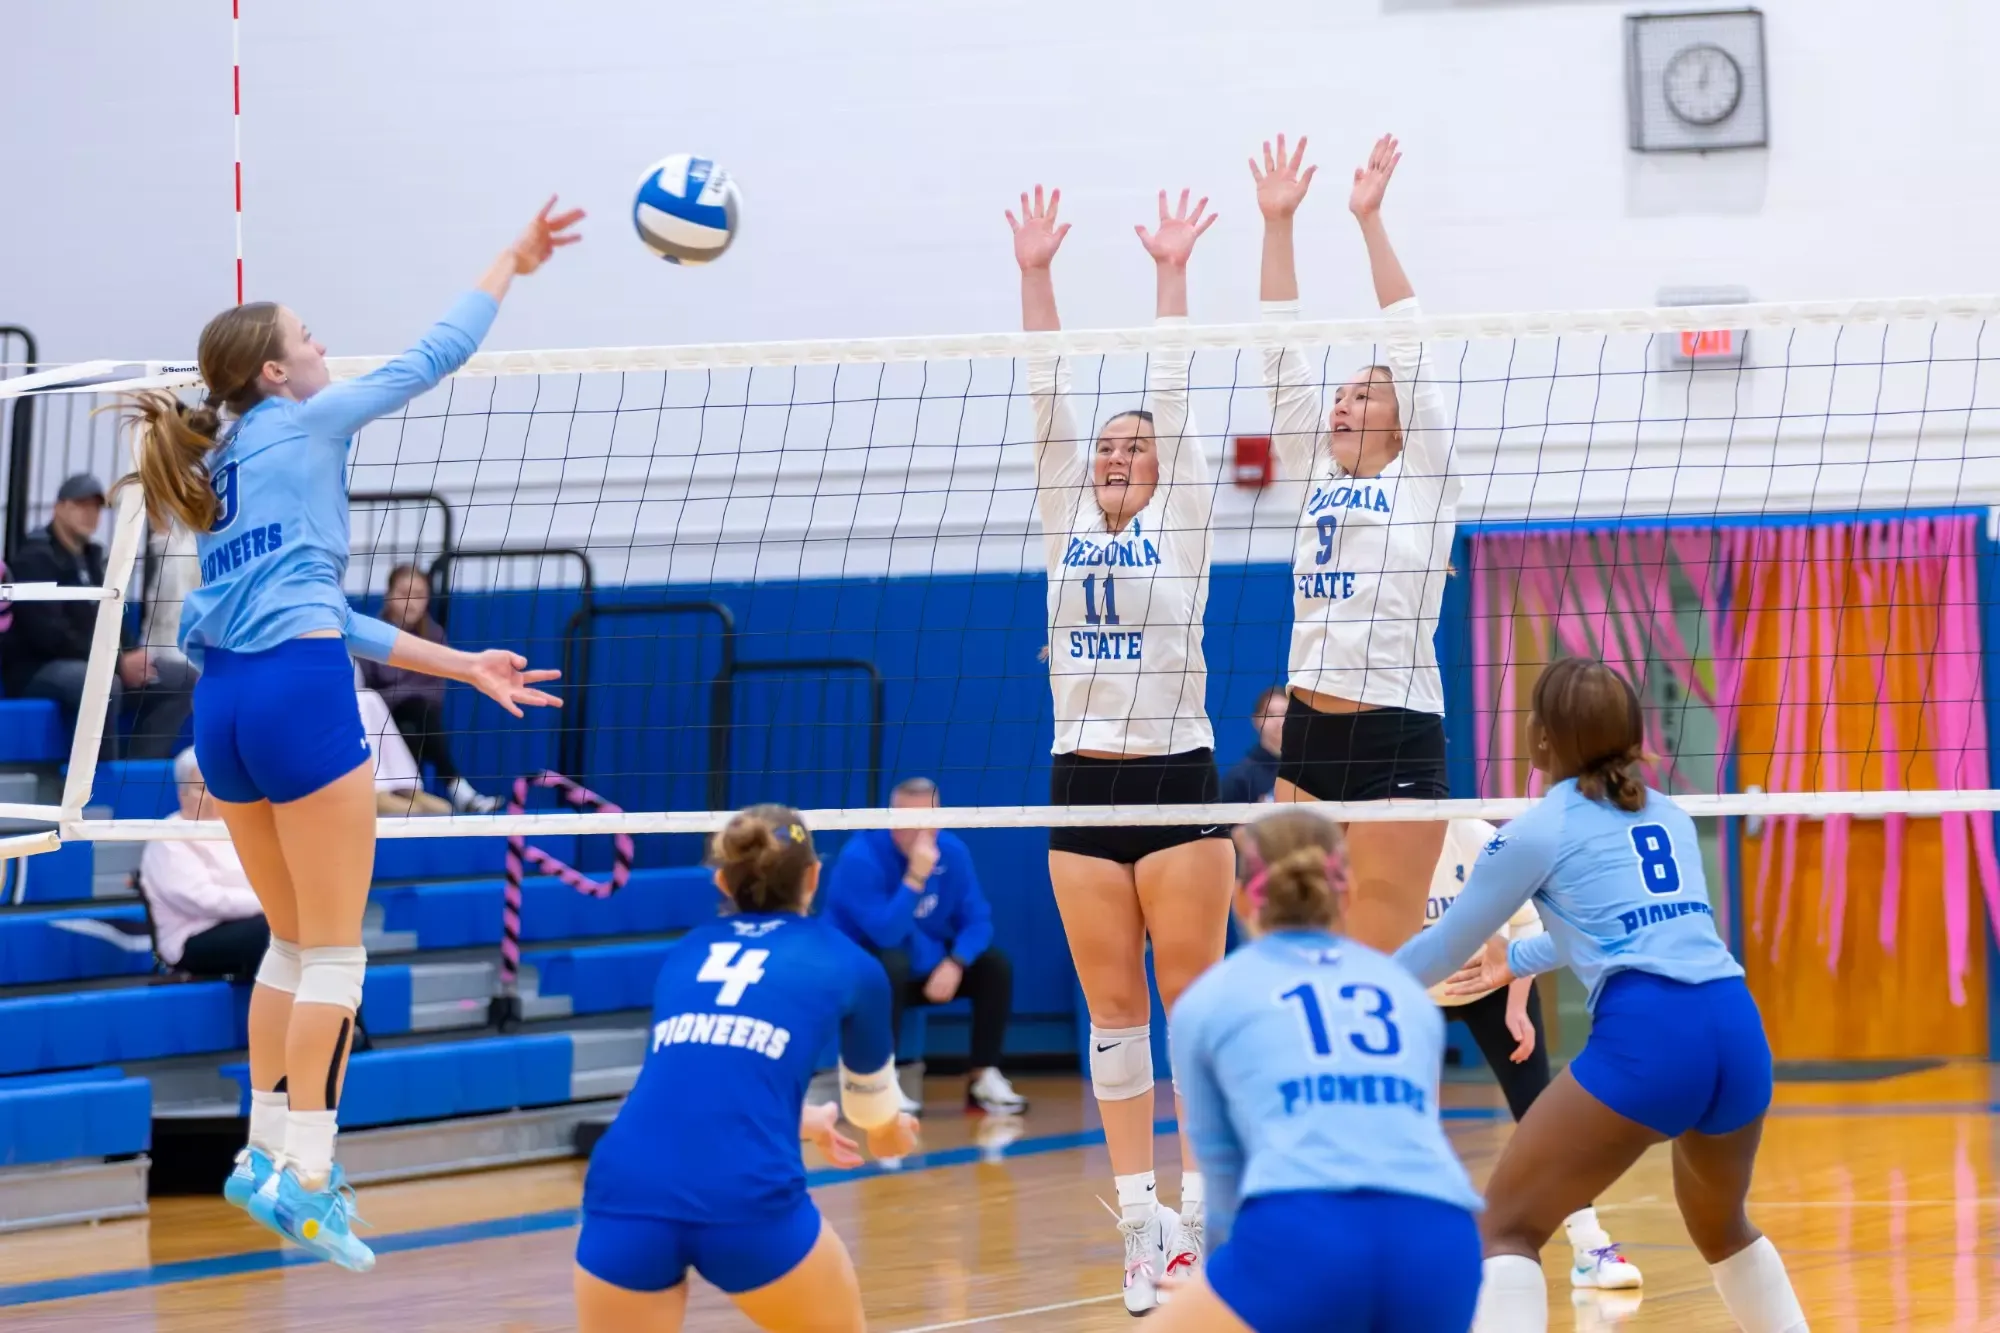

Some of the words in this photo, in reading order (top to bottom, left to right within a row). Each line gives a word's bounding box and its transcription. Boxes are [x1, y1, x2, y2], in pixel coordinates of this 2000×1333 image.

[1315, 515, 1337, 566] 9
[1082, 573, 1120, 625] 11
[1070, 630, 1142, 660] STATE
[1627, 822, 1684, 897] 8
[696, 942, 770, 1006] 4
[653, 1012, 791, 1060] PIONEERS
[1279, 981, 1403, 1058] 13
